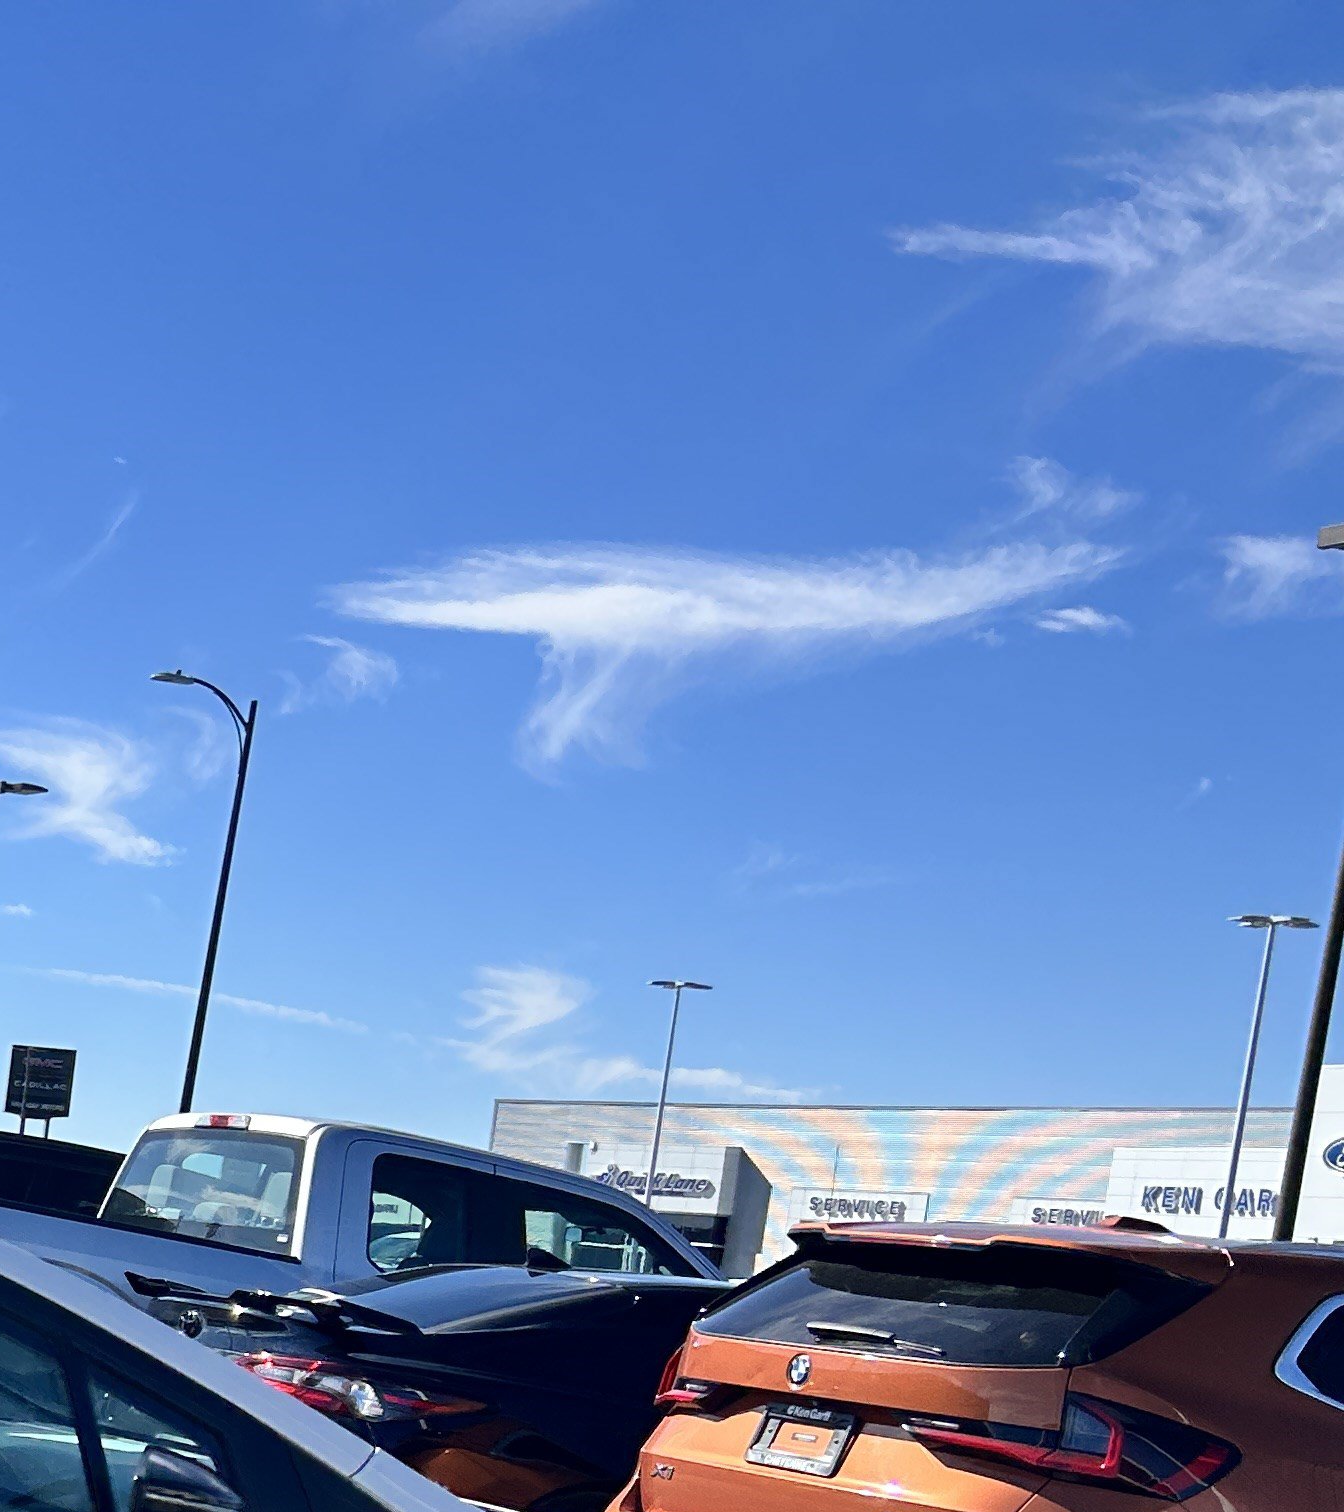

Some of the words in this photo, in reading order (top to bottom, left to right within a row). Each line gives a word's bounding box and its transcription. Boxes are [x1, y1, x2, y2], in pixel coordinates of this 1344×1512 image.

[664, 1173, 708, 1193] Lane
[809, 1196, 902, 1216] SERVICE
[1141, 1185, 1199, 1211] KEN
